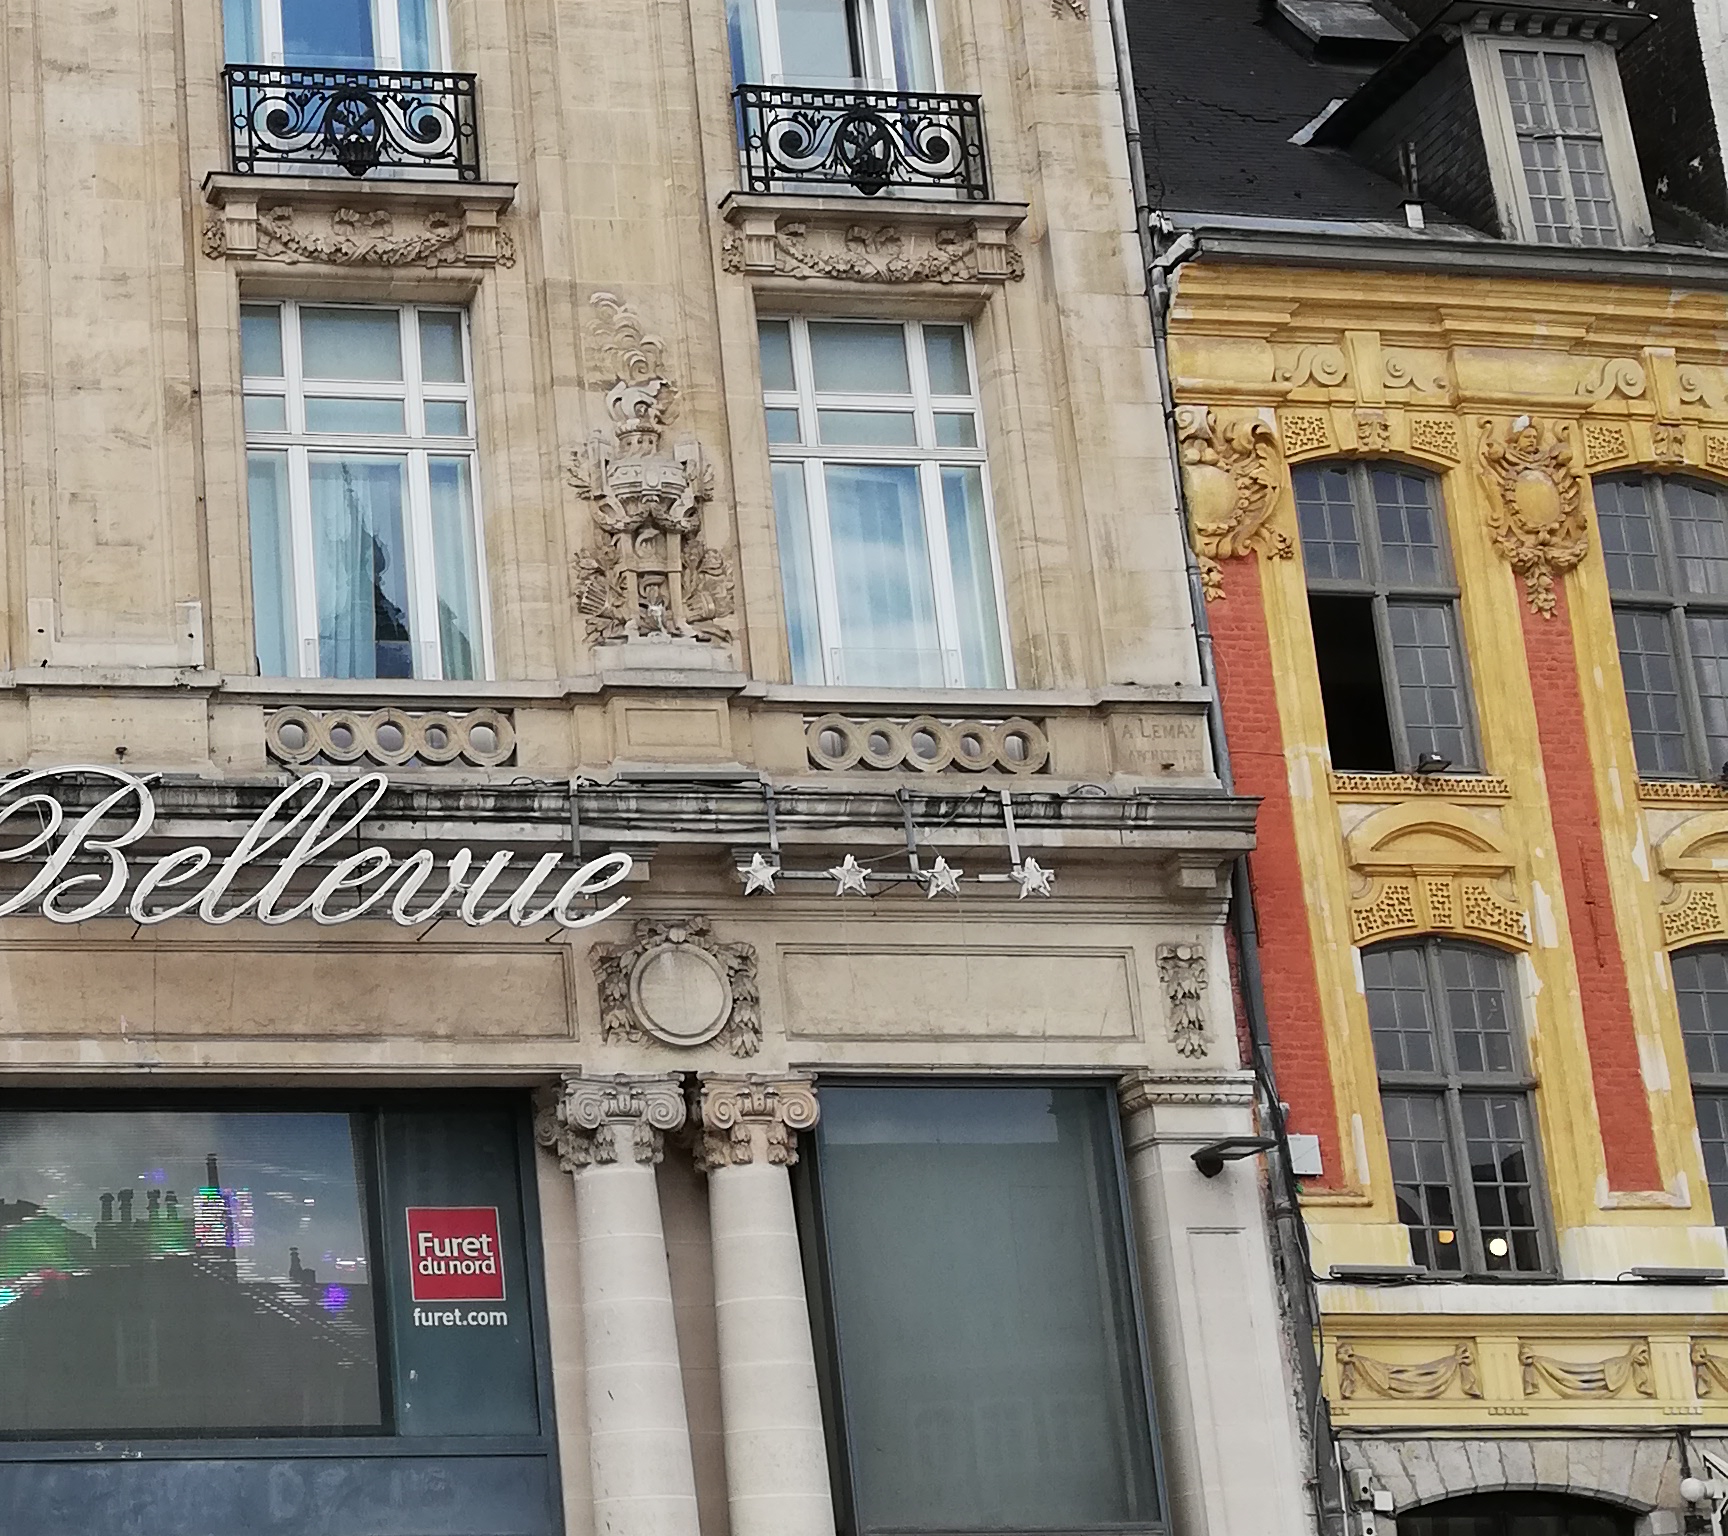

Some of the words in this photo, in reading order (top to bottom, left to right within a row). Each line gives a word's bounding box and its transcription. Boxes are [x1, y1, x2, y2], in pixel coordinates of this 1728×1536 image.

[1137, 717, 1197, 739] LEMAY
[417, 1232, 494, 1258] Furet
[418, 1256, 447, 1275] du
[449, 1256, 497, 1275] nord
[413, 1307, 509, 1327] furet.com
